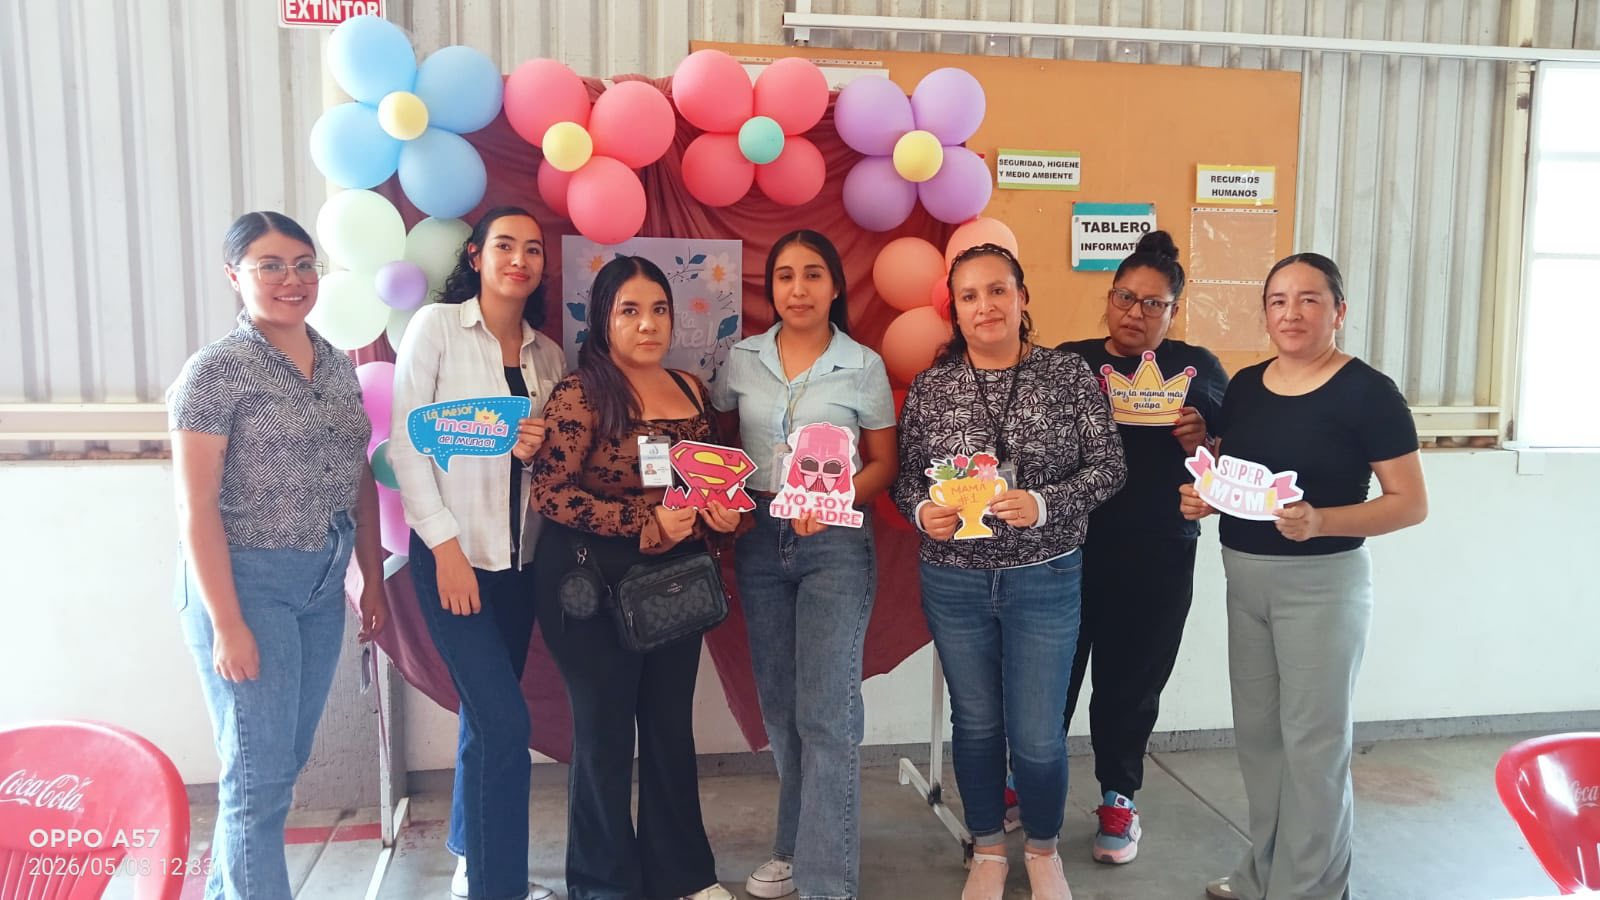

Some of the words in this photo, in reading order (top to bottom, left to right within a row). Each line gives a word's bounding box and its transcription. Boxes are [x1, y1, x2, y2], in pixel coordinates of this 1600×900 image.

[284, 0, 379, 21] EXTINTOR
[999, 159, 1046, 169] SEGURIDAD,
[1047, 161, 1080, 169] HIGIENE
[1032, 172, 1073, 180] AMBIENTE
[1210, 175, 1261, 184] RECURSOS
[1211, 188, 1259, 197] HUMANOS
[1081, 221, 1151, 233] TABLERO
[1080, 242, 1138, 251] INFORMAT
[1112, 388, 1126, 398] Soy
[1128, 388, 1137, 397] la
[1133, 401, 1161, 410] guapa
[1219, 459, 1264, 486] SUPER
[1209, 478, 1265, 513] MOM
[784, 492, 808, 506] YO
[814, 495, 851, 511] SOY
[771, 503, 792, 517] TU
